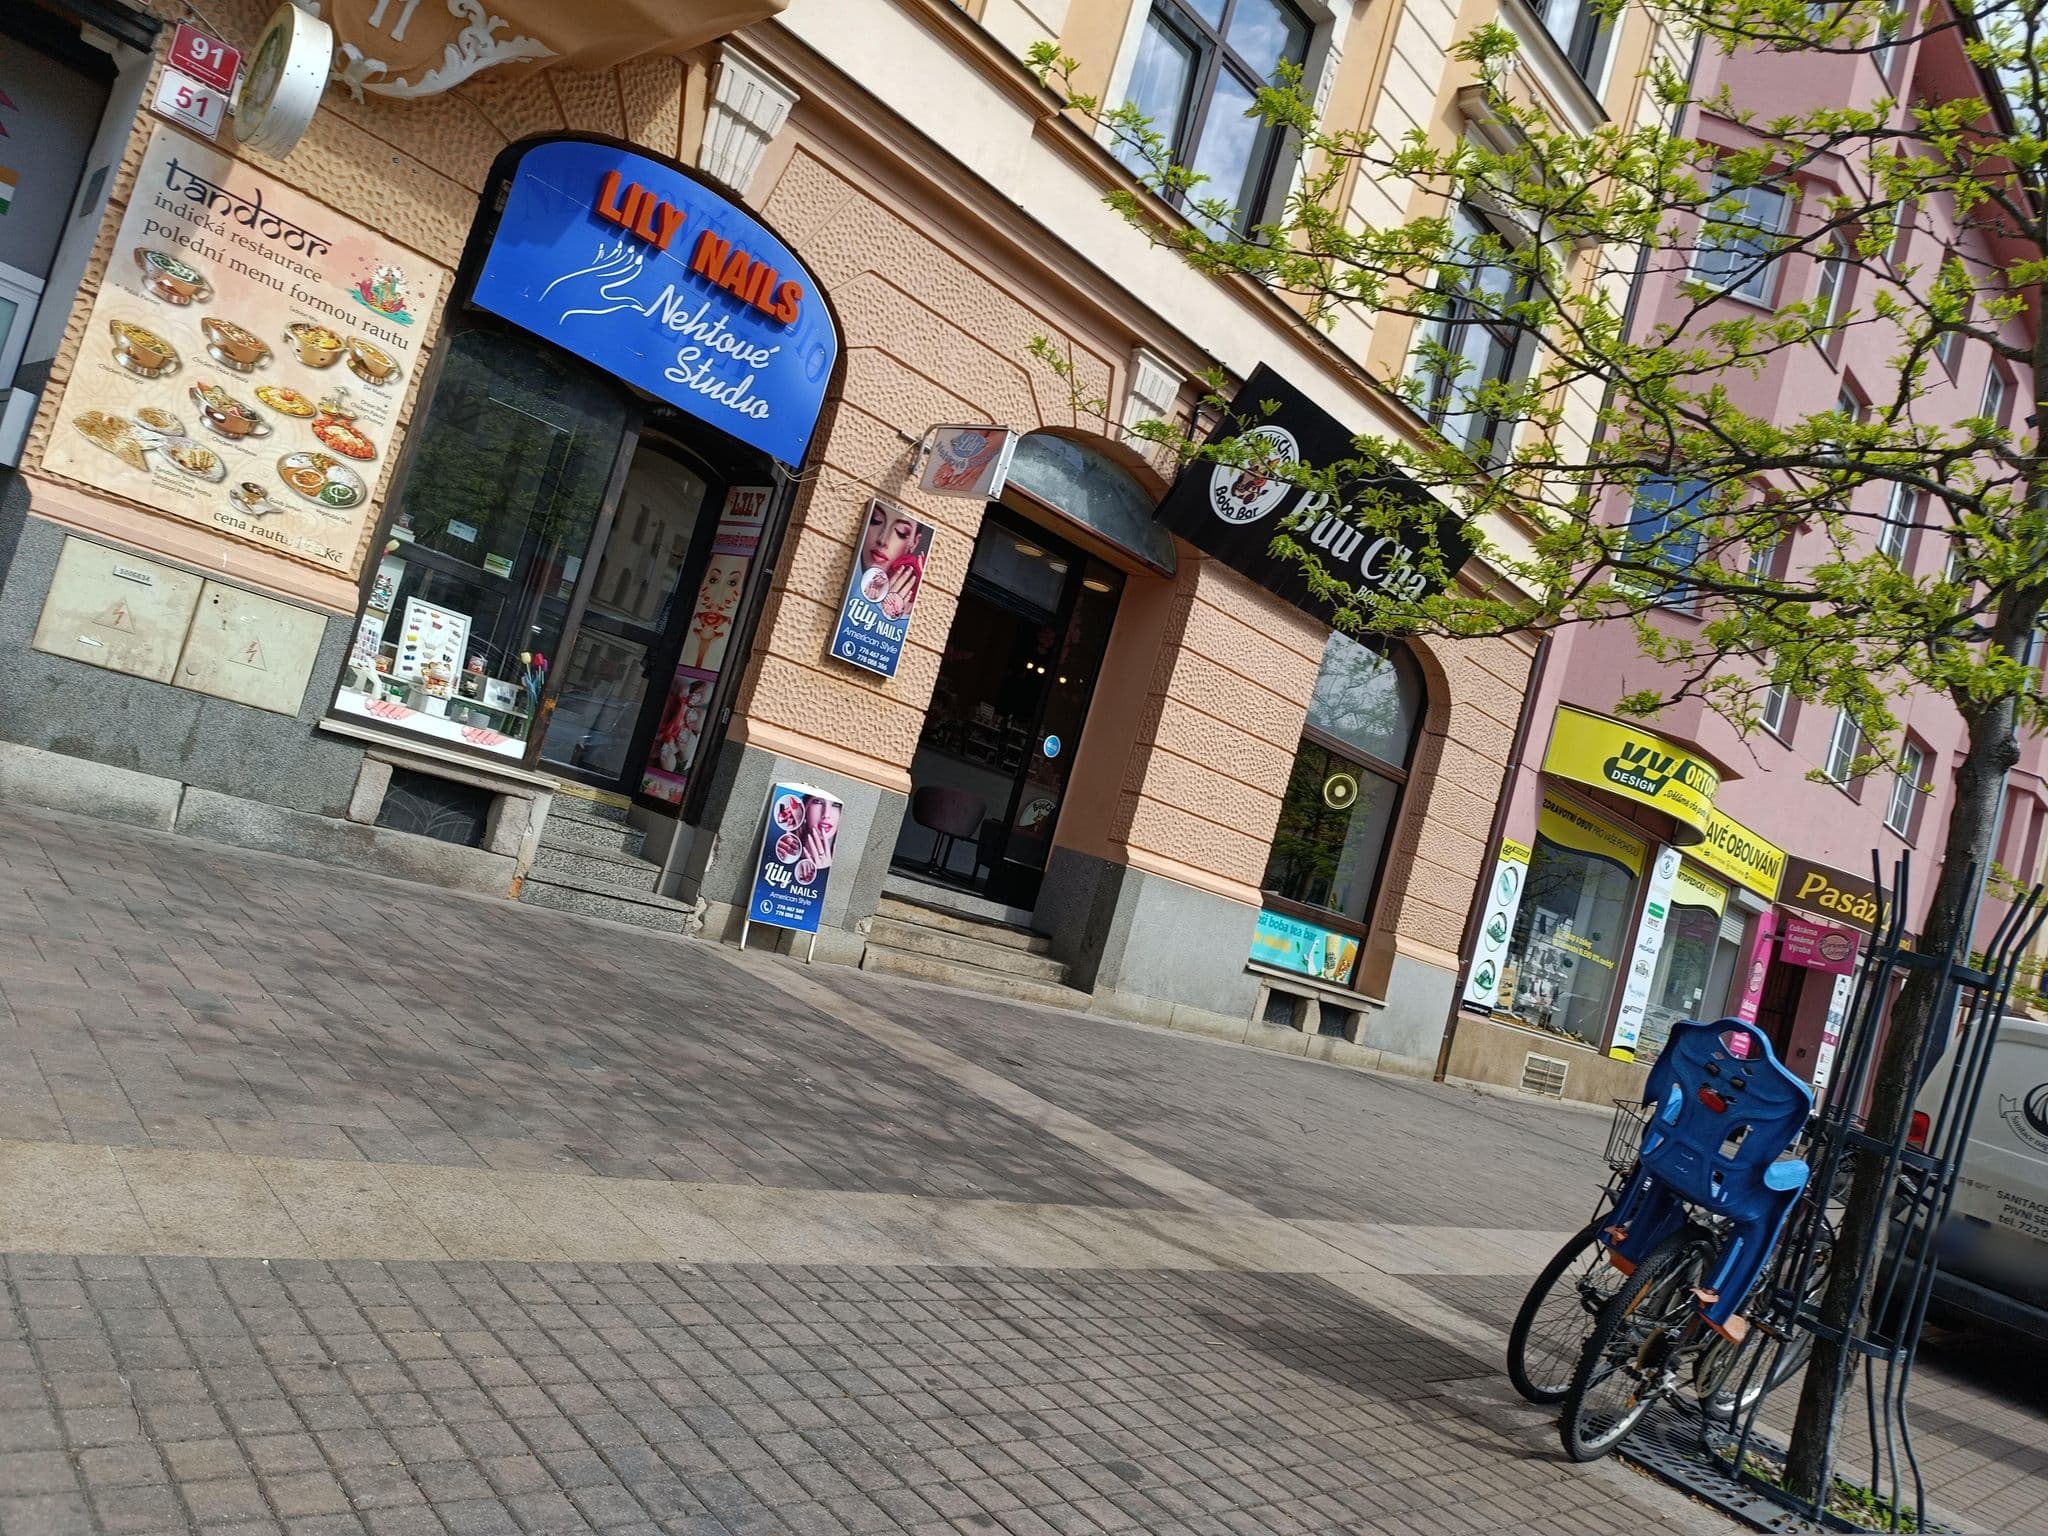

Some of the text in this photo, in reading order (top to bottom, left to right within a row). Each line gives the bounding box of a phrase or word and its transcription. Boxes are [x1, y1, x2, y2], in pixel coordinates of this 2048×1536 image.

[190, 37, 225, 70] 91
[175, 86, 209, 118] 51
[166, 157, 333, 258] tandoor
[596, 169, 687, 251] LILY
[154, 192, 323, 283] indická restaurace
[142, 218, 410, 350] polední menu formou rautu
[692, 229, 804, 325] NAILS
[643, 284, 780, 370] Nehtové
[664, 346, 770, 420] Studio
[1215, 485, 1258, 519] Boba Bar
[213, 512, 247, 531] cena
[842, 626, 880, 648] American
[848, 598, 903, 642] Lily NAILS
[1611, 770, 1656, 793] DESIGN
[1726, 833, 1779, 880] OBOUVÁNÍ
[764, 861, 818, 899] Lily NAILS
[769, 891, 798, 904] American
[1267, 915, 1289, 932] boba
[1290, 924, 1303, 937] tea
[1303, 926, 1317, 941] bar
[2018, 1221, 2040, 1235] 722
